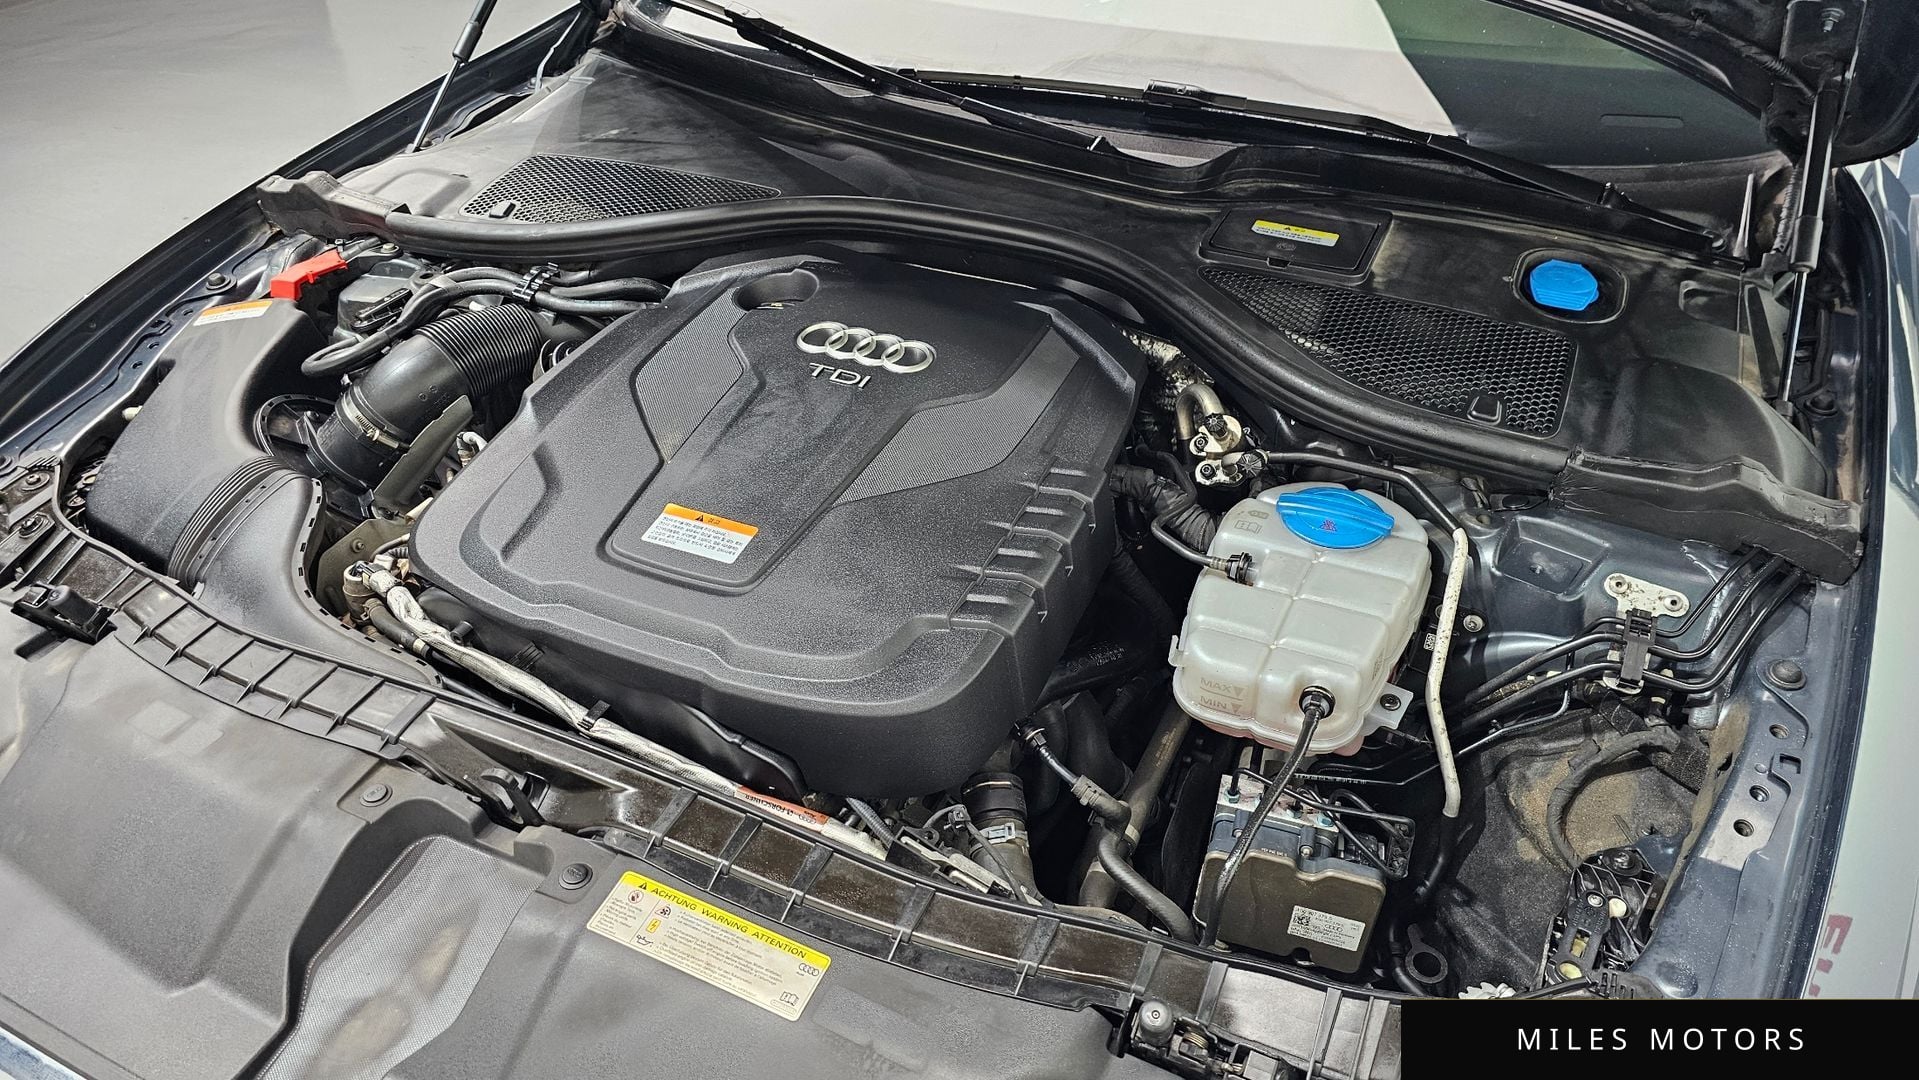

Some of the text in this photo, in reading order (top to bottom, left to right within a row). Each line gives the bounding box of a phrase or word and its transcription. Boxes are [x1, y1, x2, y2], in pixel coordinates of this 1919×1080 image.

[809, 362, 872, 390] TDI
[1200, 677, 1231, 693] MAX
[1200, 695, 1227, 710] MIN
[651, 887, 807, 959] ACHTUNG WARNING ATTENTION
